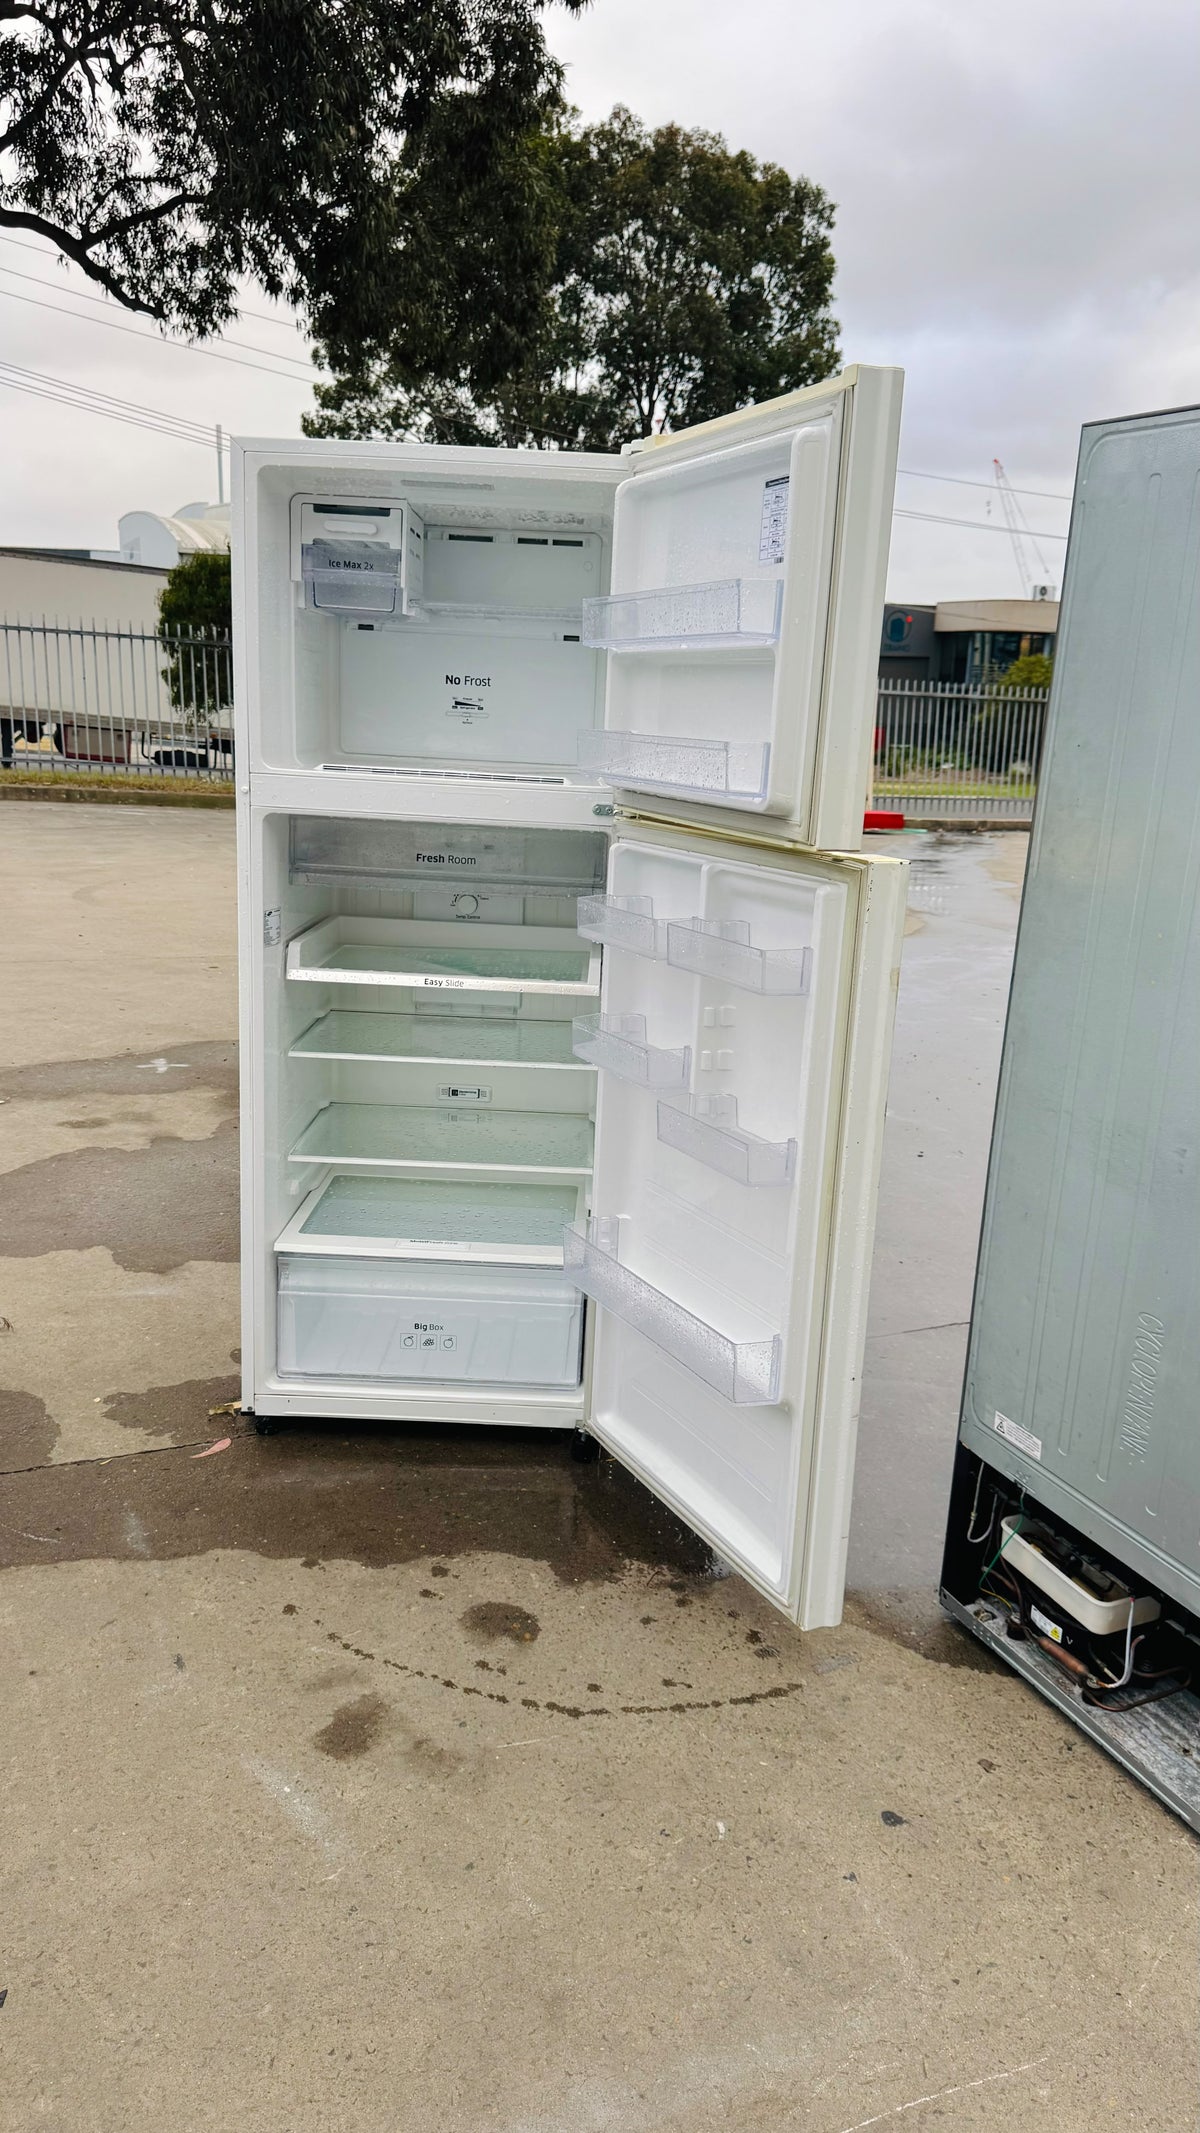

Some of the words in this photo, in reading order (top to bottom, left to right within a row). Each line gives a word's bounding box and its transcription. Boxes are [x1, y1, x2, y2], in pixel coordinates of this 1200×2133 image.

[328, 559, 341, 568] Ice
[343, 560, 362, 569] Max
[364, 561, 374, 571] 2x
[445, 674, 461, 686] No
[464, 675, 491, 687] Frost
[416, 853, 445, 863] Fresh
[447, 854, 476, 865] Room
[424, 978, 443, 987] Easy
[445, 979, 464, 988] Slide
[414, 1322, 428, 1332] Big
[429, 1323, 444, 1331] Box
